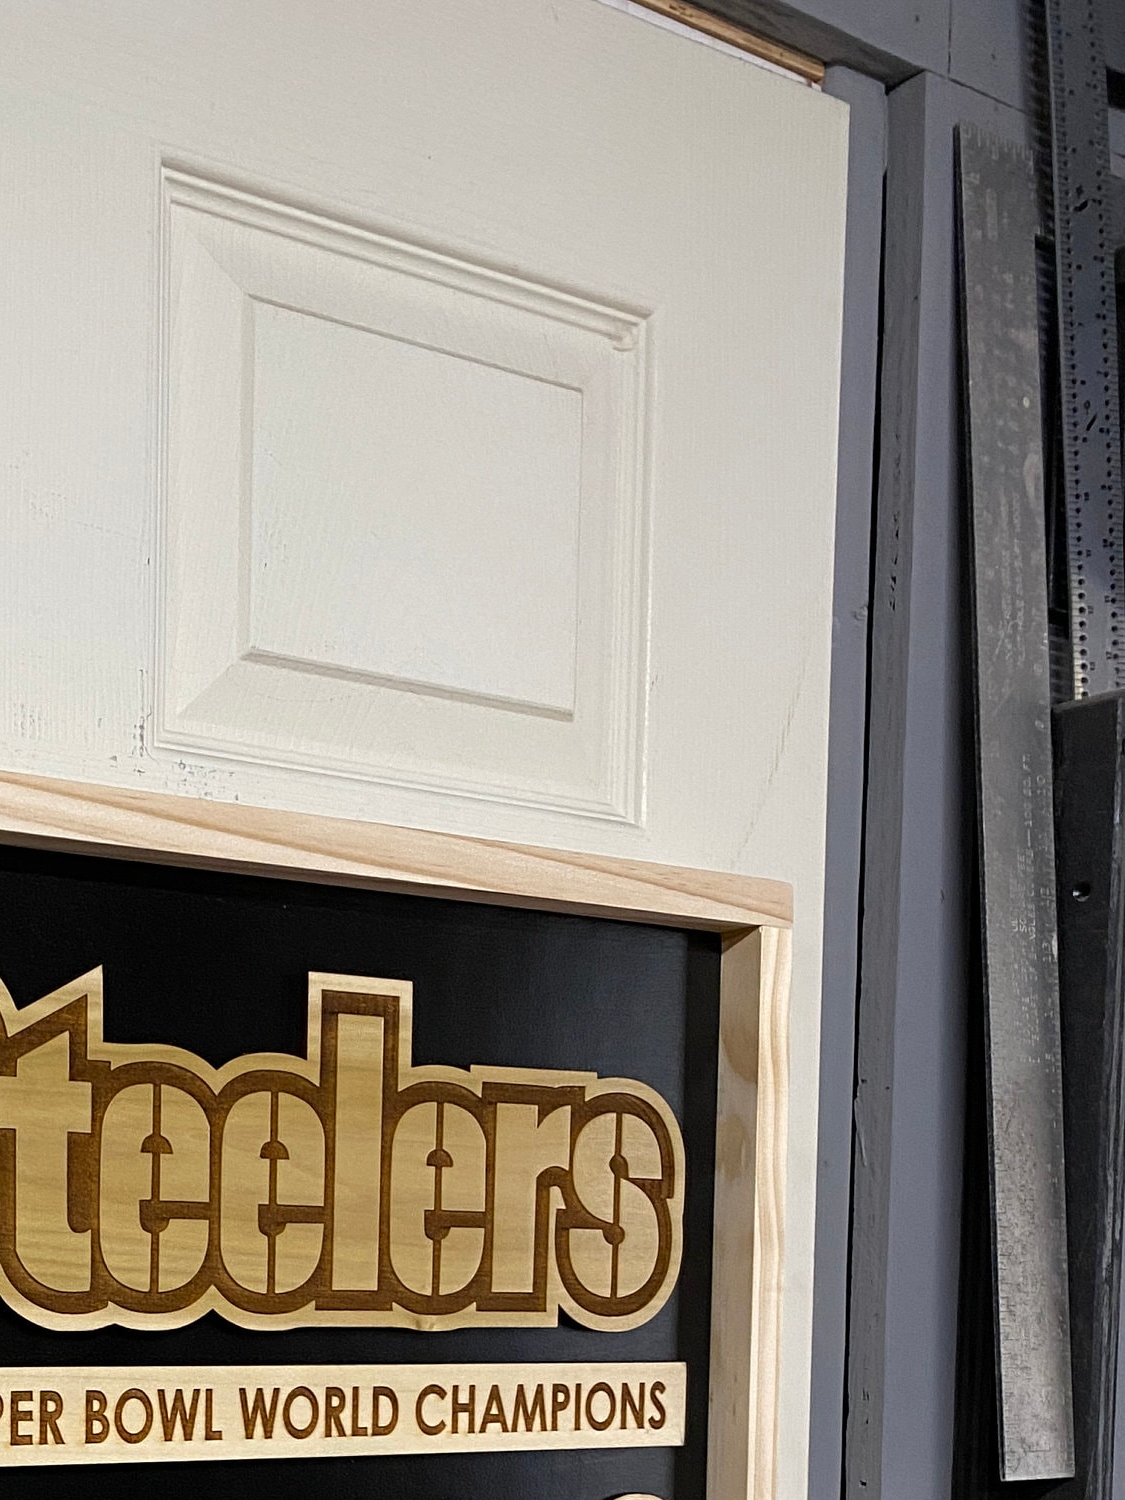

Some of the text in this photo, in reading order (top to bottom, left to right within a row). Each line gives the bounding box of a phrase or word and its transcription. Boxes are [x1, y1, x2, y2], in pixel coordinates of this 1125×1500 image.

[85, 1387, 223, 1444] BOWL
[239, 1385, 399, 1440] WORLD
[414, 1380, 667, 1436] CHAMPIONS
